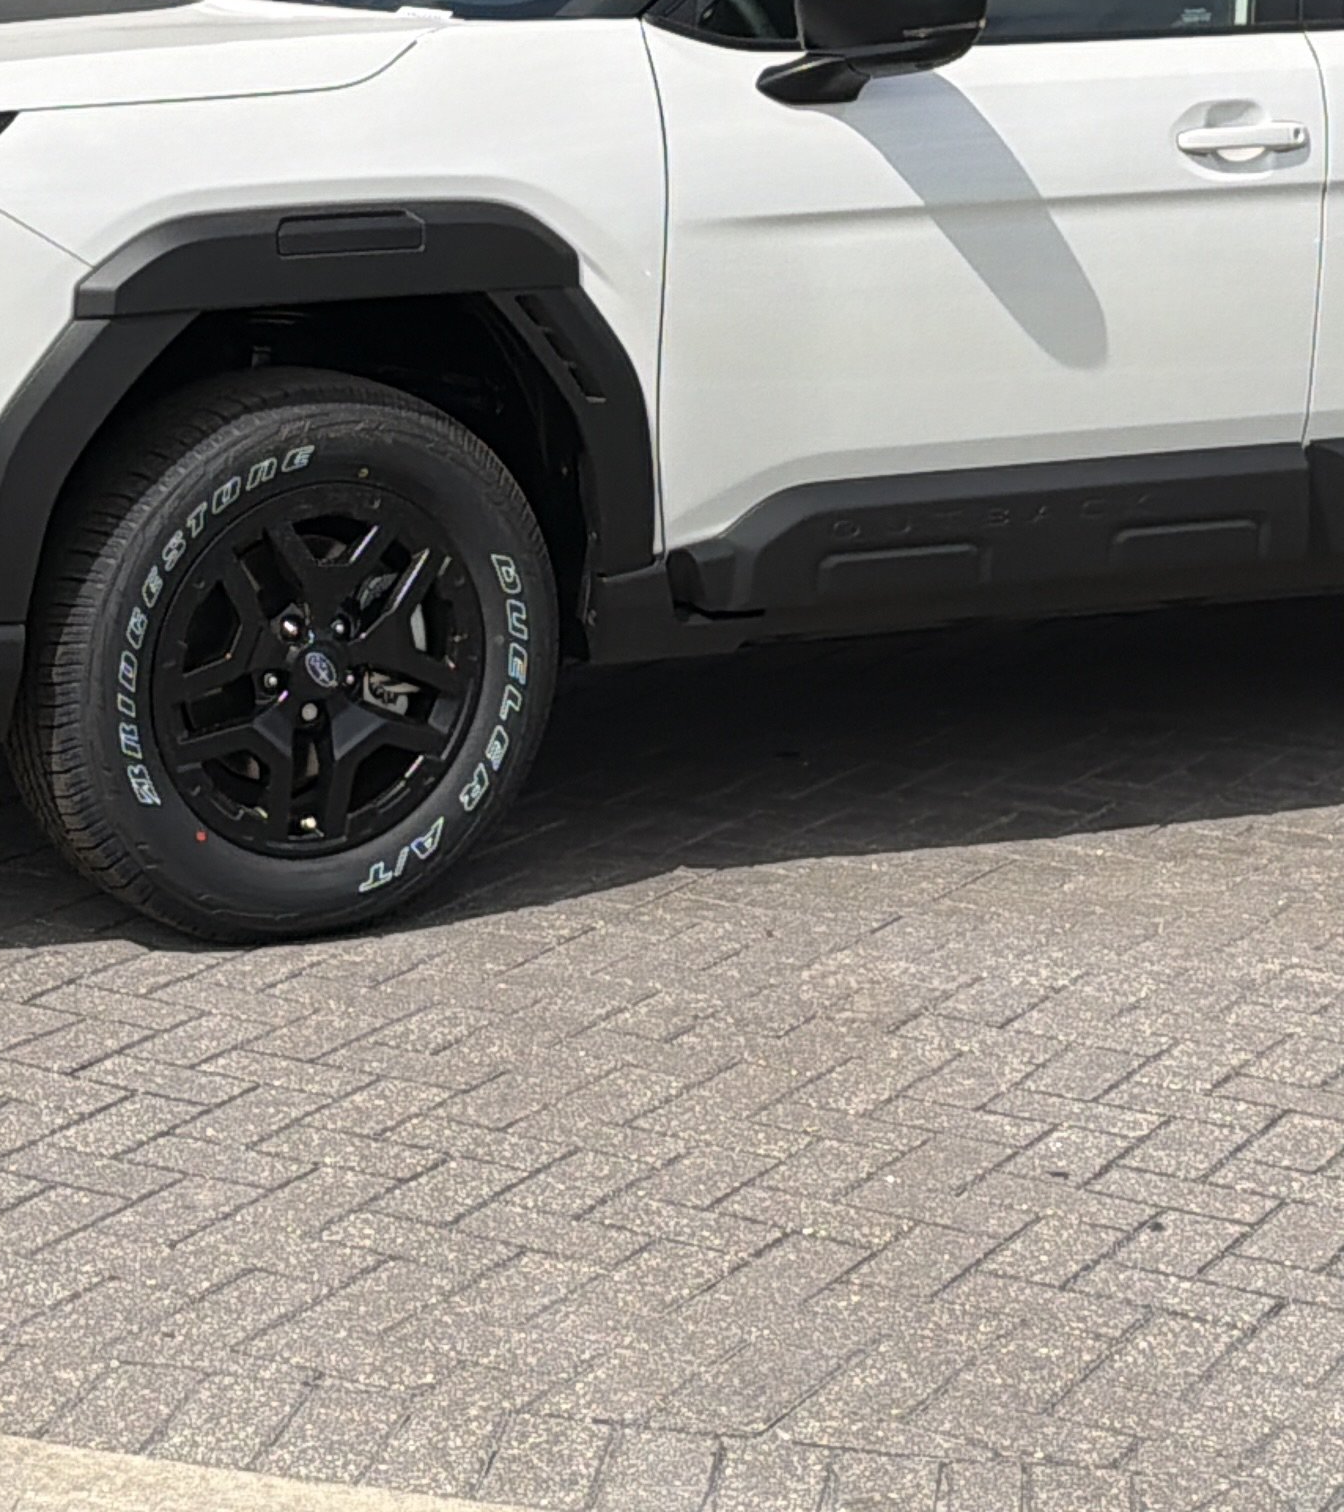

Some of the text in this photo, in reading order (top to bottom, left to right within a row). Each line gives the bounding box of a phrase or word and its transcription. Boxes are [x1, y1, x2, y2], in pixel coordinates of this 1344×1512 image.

[117, 445, 315, 806] BRIDGESTONE
[358, 552, 529, 892] DUELER A/T
